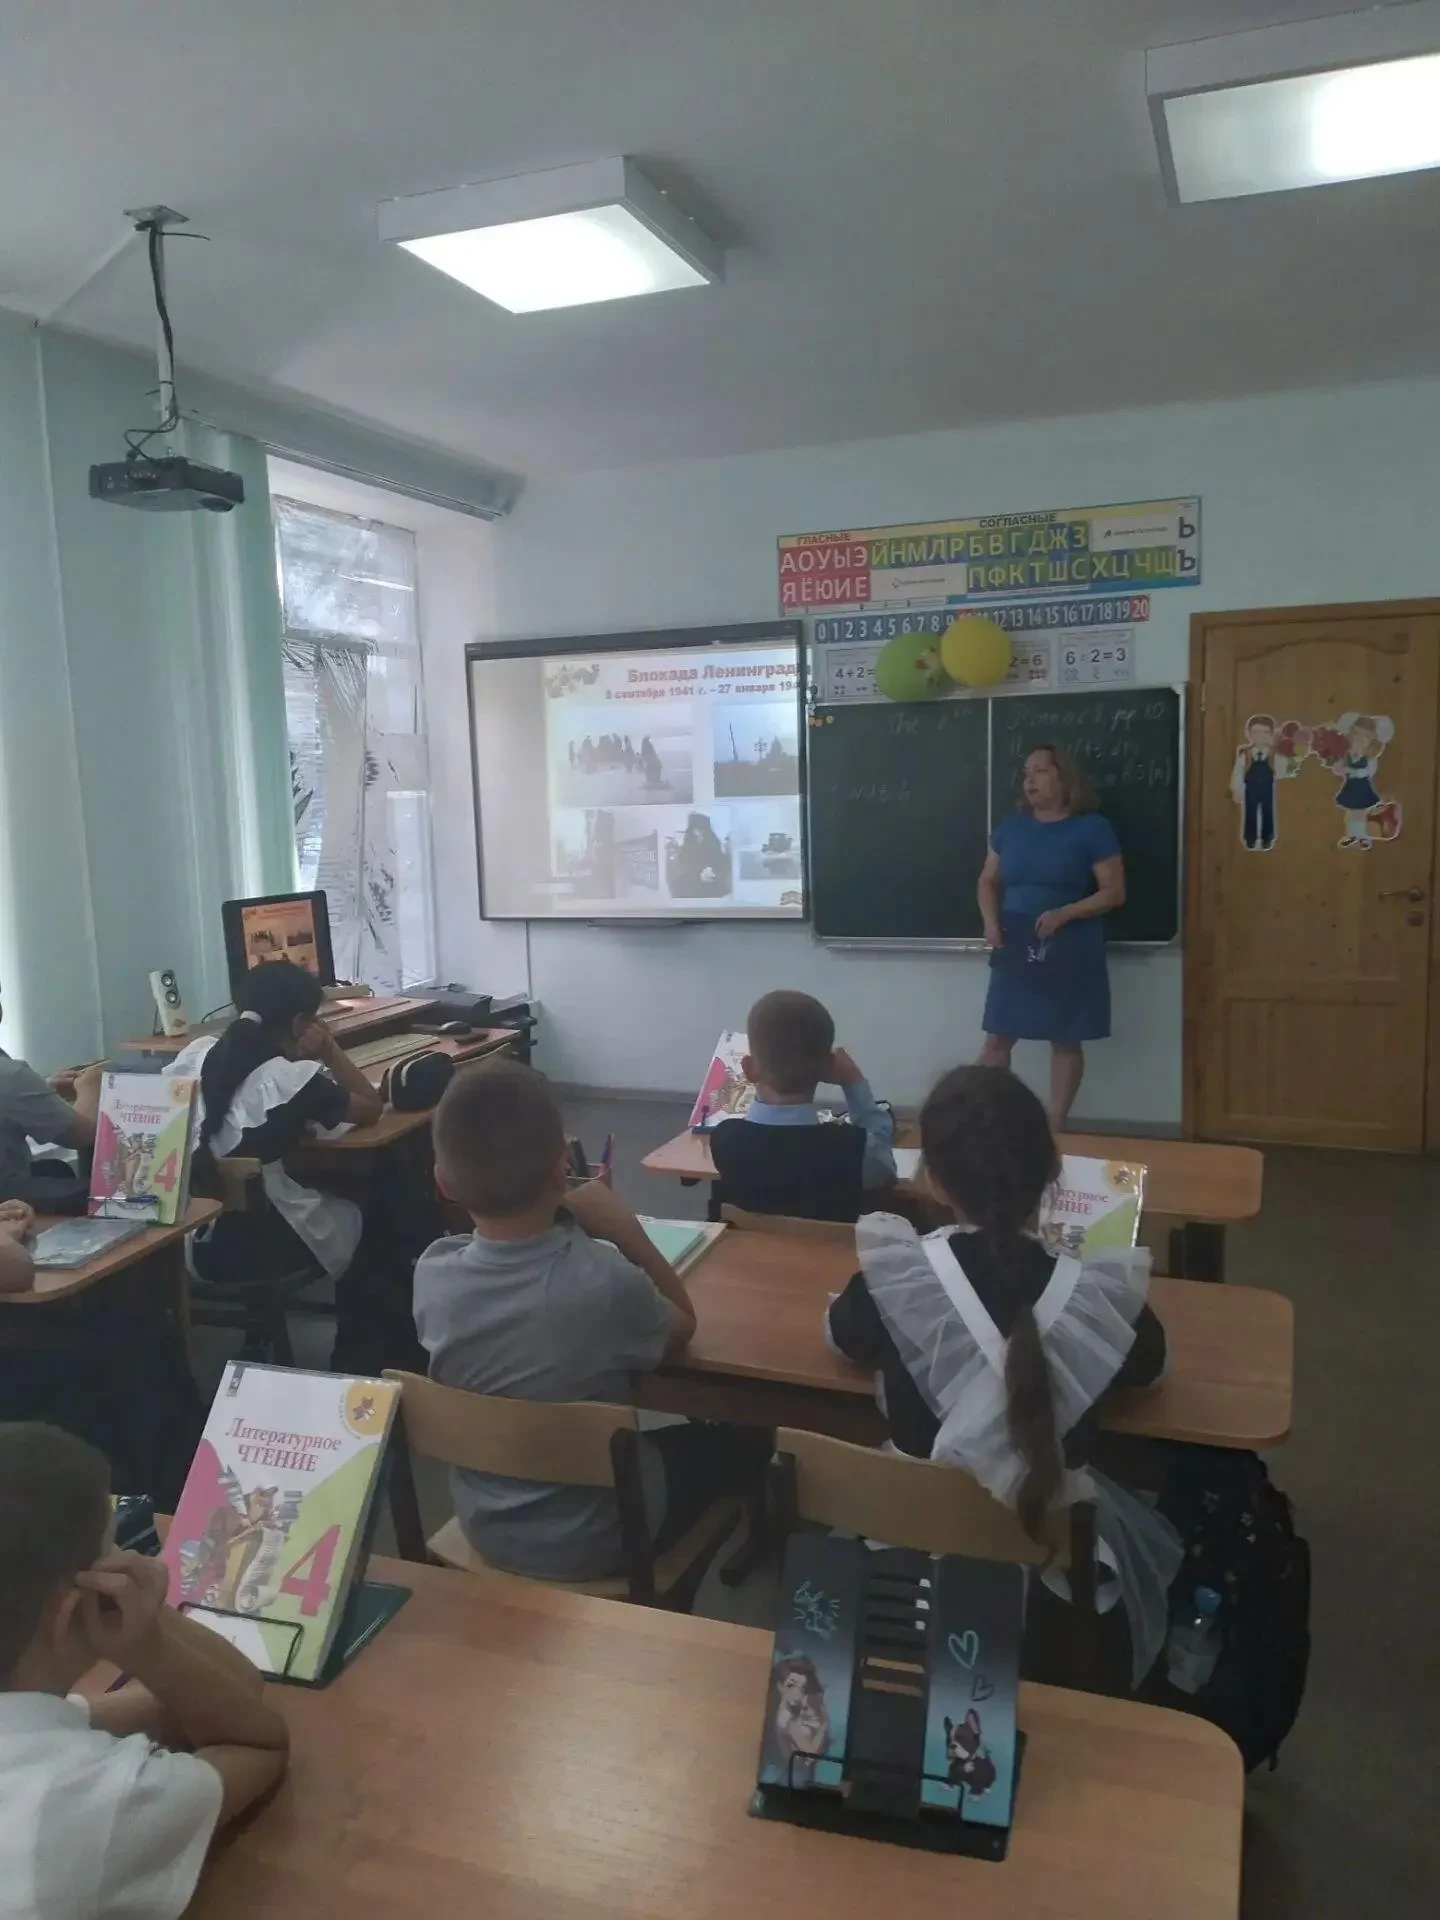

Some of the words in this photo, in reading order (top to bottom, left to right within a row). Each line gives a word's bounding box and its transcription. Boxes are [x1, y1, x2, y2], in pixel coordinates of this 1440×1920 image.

[979, 512, 1057, 528] СОГЛАСНЫЕ
[797, 532, 851, 545] ГЛАСНЫЕ
[817, 623, 826, 640] 0
[832, 622, 839, 639] 1
[844, 621, 854, 638] 2
[859, 620, 868, 638] 3
[873, 619, 883, 637] 4
[888, 618, 896, 635] 5
[902, 617, 912, 633] 6
[917, 616, 925, 632] 7
[931, 615, 940, 632] 8
[1010, 609, 1023, 627] 13
[1028, 607, 1040, 625] 14
[1045, 606, 1059, 624] 15
[1063, 605, 1077, 623] 16
[1081, 604, 1094, 621] 17
[1099, 602, 1113, 620] 18
[1116, 600, 1130, 618] 19
[1132, 598, 1149, 617] 20
[627, 667, 698, 683] Блокада
[669, 686, 695, 697] 1941
[718, 684, 731, 694] 27
[735, 683, 776, 695] января
[153, 1149, 178, 1193] 4
[225, 1417, 342, 1452] Литературное
[238, 1443, 321, 1473] ЧТЕНИЕ
[279, 1523, 342, 1617] 4
